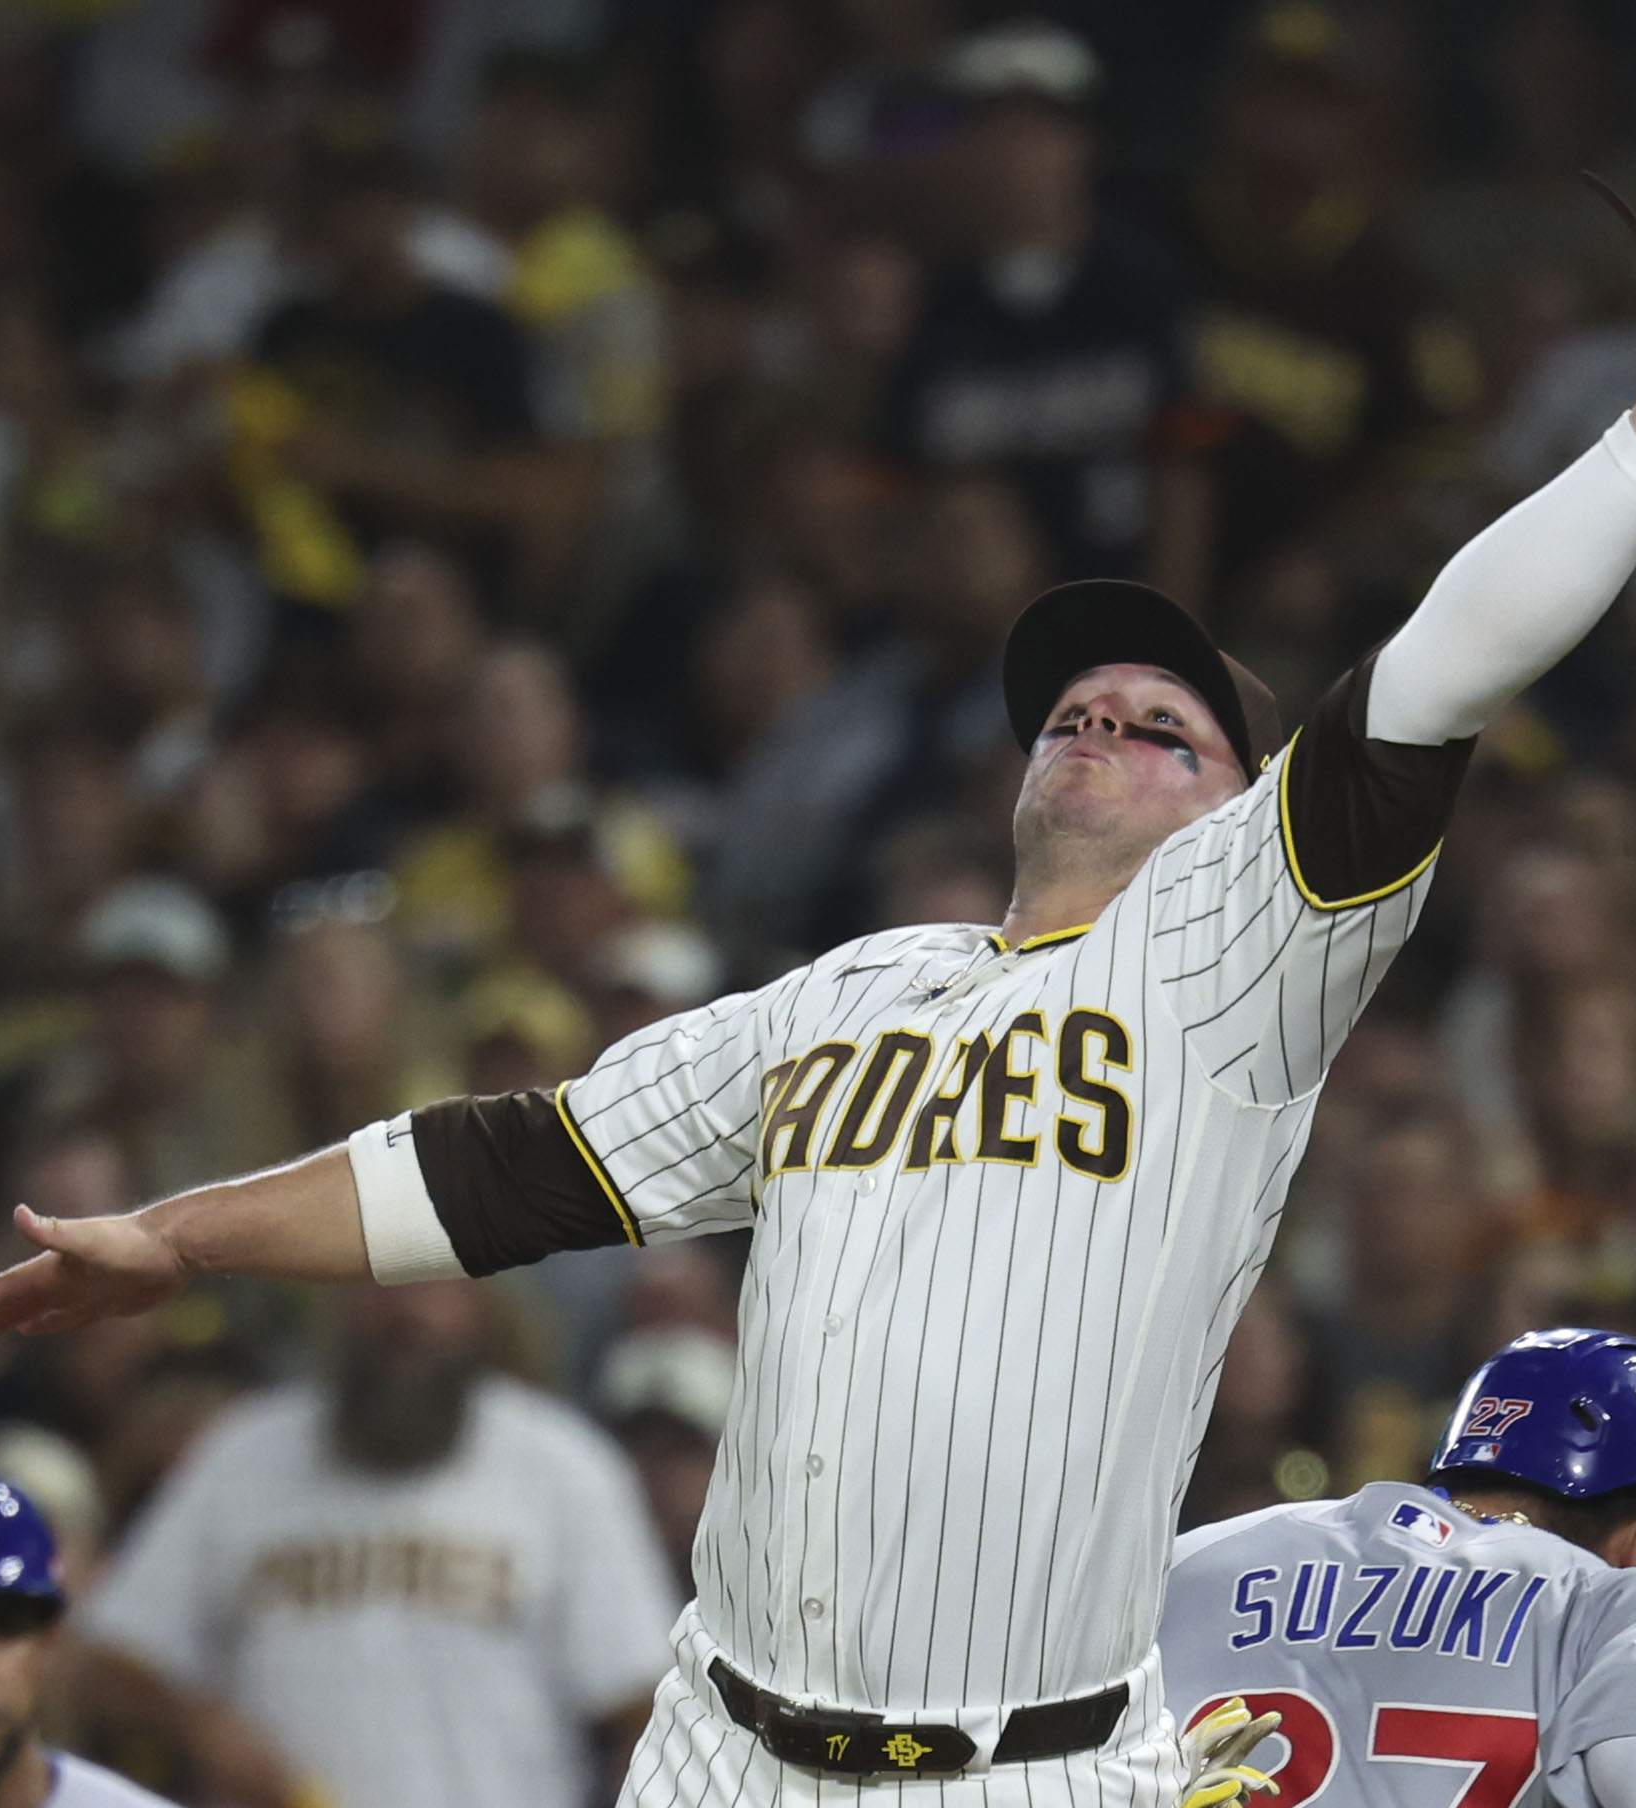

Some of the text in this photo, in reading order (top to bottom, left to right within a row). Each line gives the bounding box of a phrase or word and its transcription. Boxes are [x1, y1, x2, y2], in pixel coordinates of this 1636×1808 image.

[1462, 1396, 1534, 1436] 27
[1228, 1560, 1549, 1667] SUZUKI
[826, 1735, 850, 1761] TY
